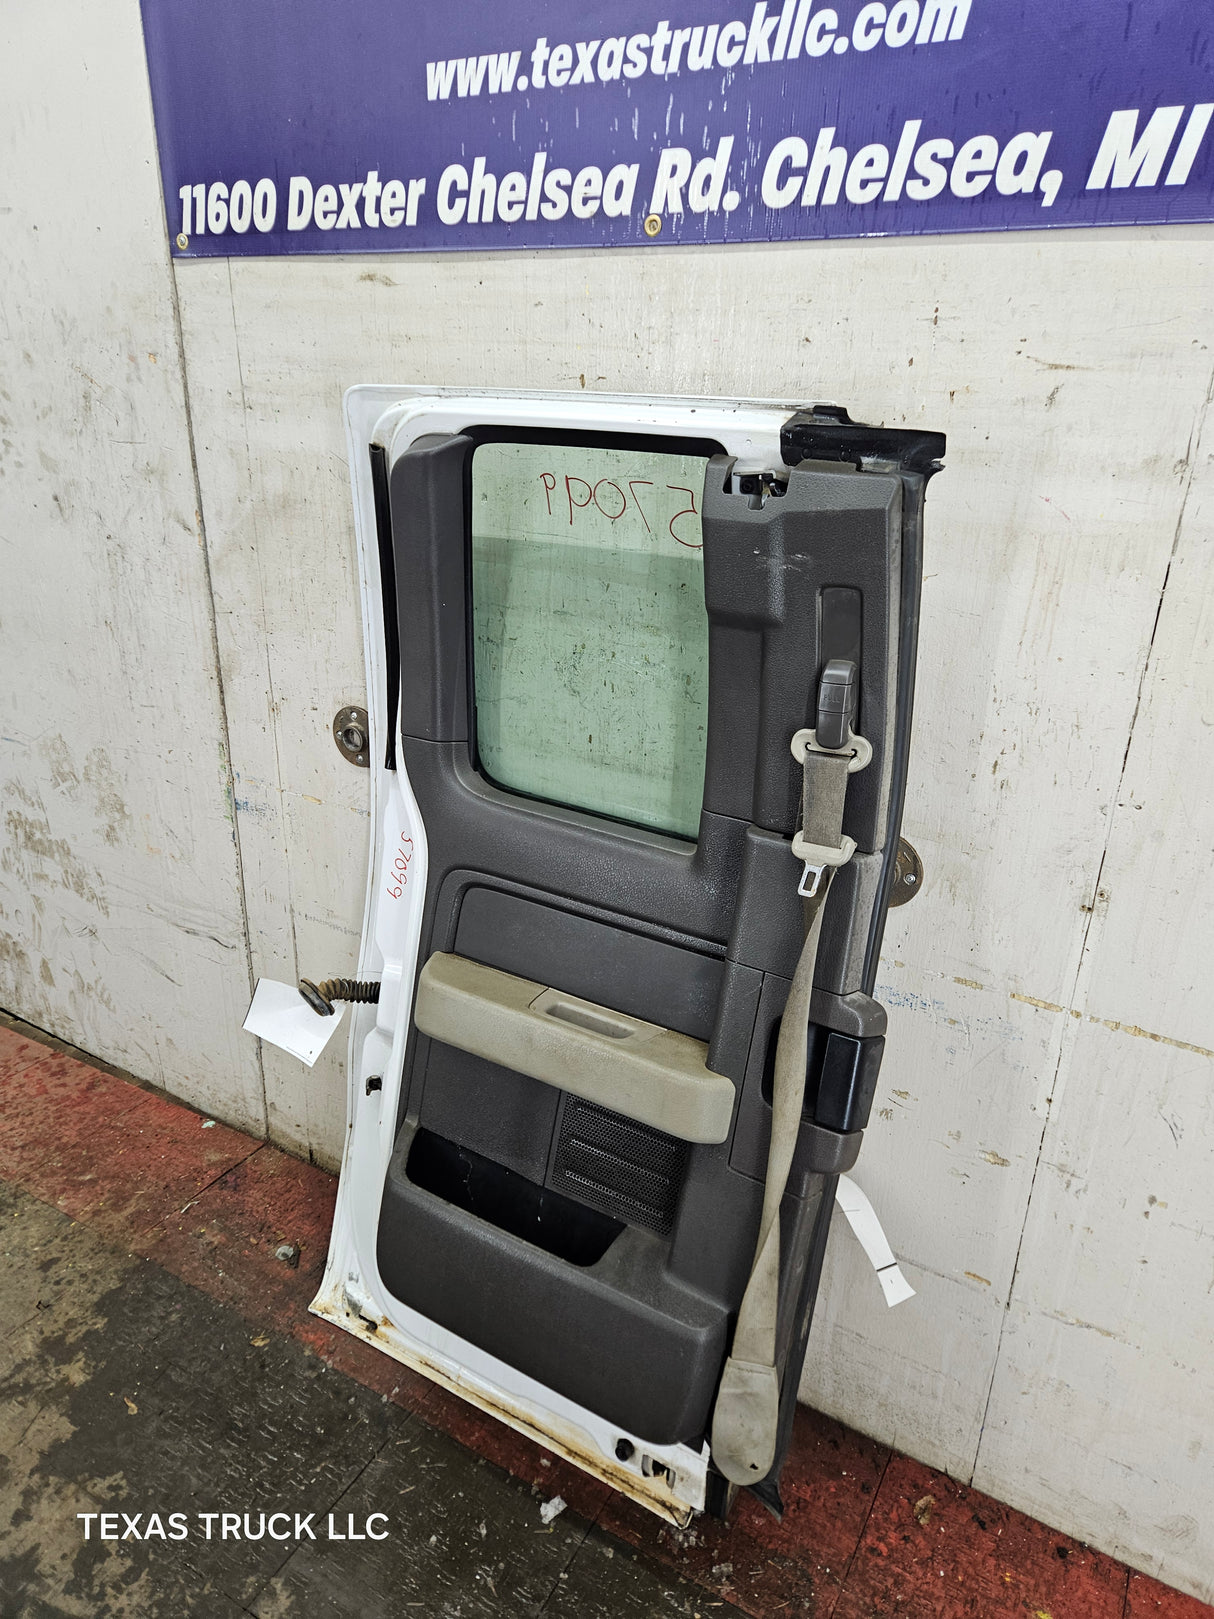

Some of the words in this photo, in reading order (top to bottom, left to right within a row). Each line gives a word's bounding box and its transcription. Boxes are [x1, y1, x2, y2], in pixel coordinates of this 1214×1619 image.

[427, 0, 972, 100] www.texastruckllc.com
[178, 178, 277, 235] 11600
[287, 170, 426, 231] Dexter
[436, 151, 639, 225] Chelsea
[649, 134, 739, 214] Rd.
[761, 119, 1063, 209] Chelsea,
[1085, 103, 1214, 190] MI
[386, 831, 414, 900] 57099
